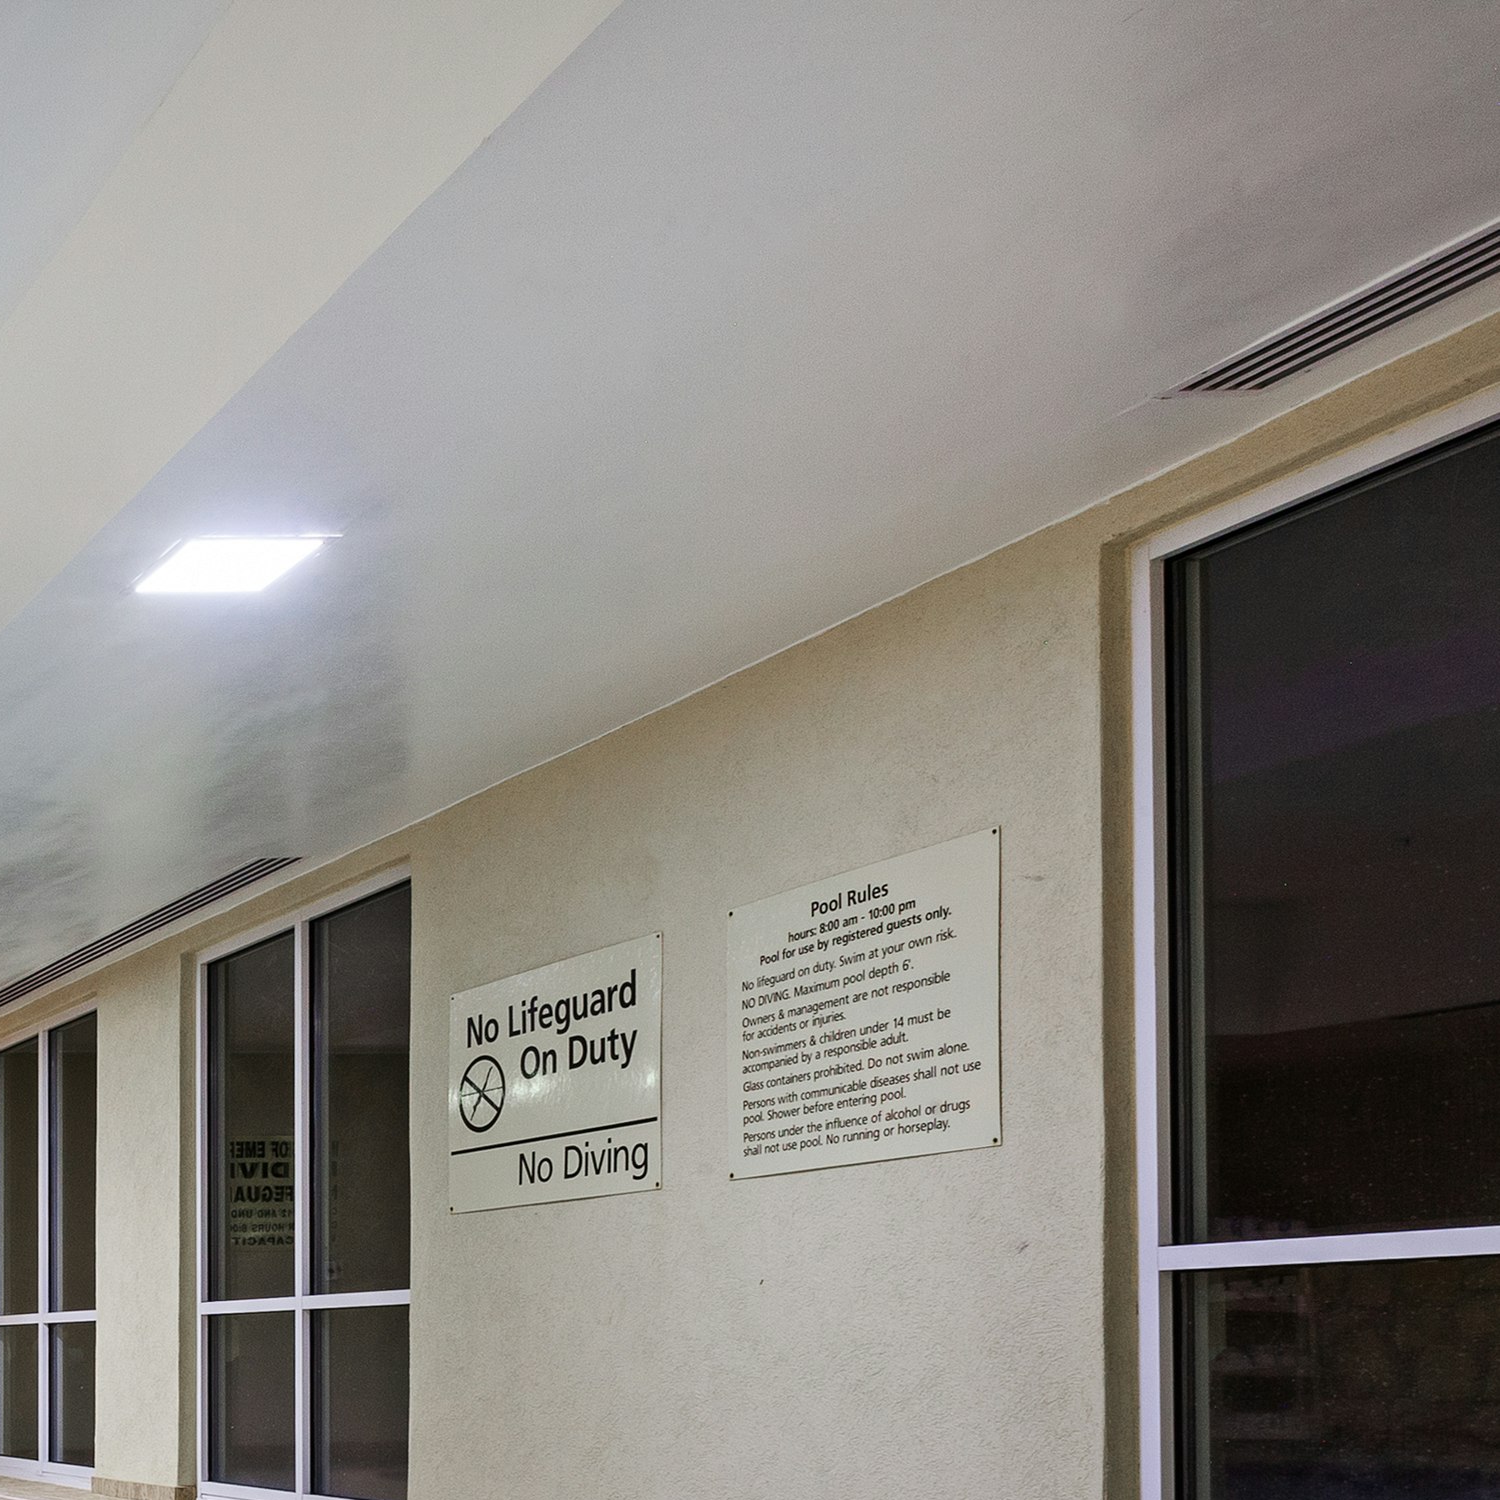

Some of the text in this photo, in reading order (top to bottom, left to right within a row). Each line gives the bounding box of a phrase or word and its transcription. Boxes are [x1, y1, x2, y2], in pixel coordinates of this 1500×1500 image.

[788, 928, 816, 943] hours:
[820, 921, 839, 934] 8:00
[843, 916, 858, 927] am
[869, 904, 895, 920] 10:00
[899, 899, 916, 915] pm
[811, 882, 889, 917] Pool Rules
[742, 982, 754, 992] No
[757, 969, 795, 988] lifeguard
[798, 967, 810, 977] on
[839, 953, 865, 967] Swim
[868, 948, 879, 960] at
[881, 940, 905, 959] your
[908, 936, 932, 949] own
[760, 952, 780, 966] Pool
[782, 949, 795, 960] for
[799, 944, 814, 955] use
[817, 935, 829, 951] by
[832, 924, 883, 946] registered
[886, 915, 922, 935] guests
[467, 969, 636, 1048] No Lifeguard
[742, 1000, 755, 1010] NO
[794, 979, 840, 998] Maximum
[843, 973, 865, 989] pool
[869, 961, 899, 982] depth
[742, 971, 950, 1028] Owners & management are not responsible
[521, 1028, 637, 1079] On Duty
[742, 1030, 754, 1042] for
[758, 1021, 797, 1039] accidents
[800, 1018, 809, 1029] or
[742, 1008, 951, 1060] Non-swimmers & children under 14 must be
[742, 1033, 908, 1075] accompanied by a responsible adult.
[743, 1081, 764, 1092] Glass
[766, 1071, 811, 1088] containers
[868, 1058, 882, 1069] Do
[885, 1054, 903, 1066] not
[906, 1049, 934, 1063] swim
[743, 1061, 981, 1111] Persons with communicable diseases shall not use
[767, 1107, 800, 1120] Shower
[803, 1100, 834, 1115] before
[837, 1093, 877, 1111] entering
[880, 1087, 906, 1104] pool.
[743, 1145, 762, 1157] shall
[764, 1144, 779, 1154] not
[782, 1140, 797, 1151] use
[826, 1134, 840, 1145] No
[843, 1129, 880, 1143] running
[883, 1126, 894, 1137] or
[744, 1098, 971, 1143] Persons under the influence of alcohol or drugs
[519, 1138, 648, 1185] No Diving
